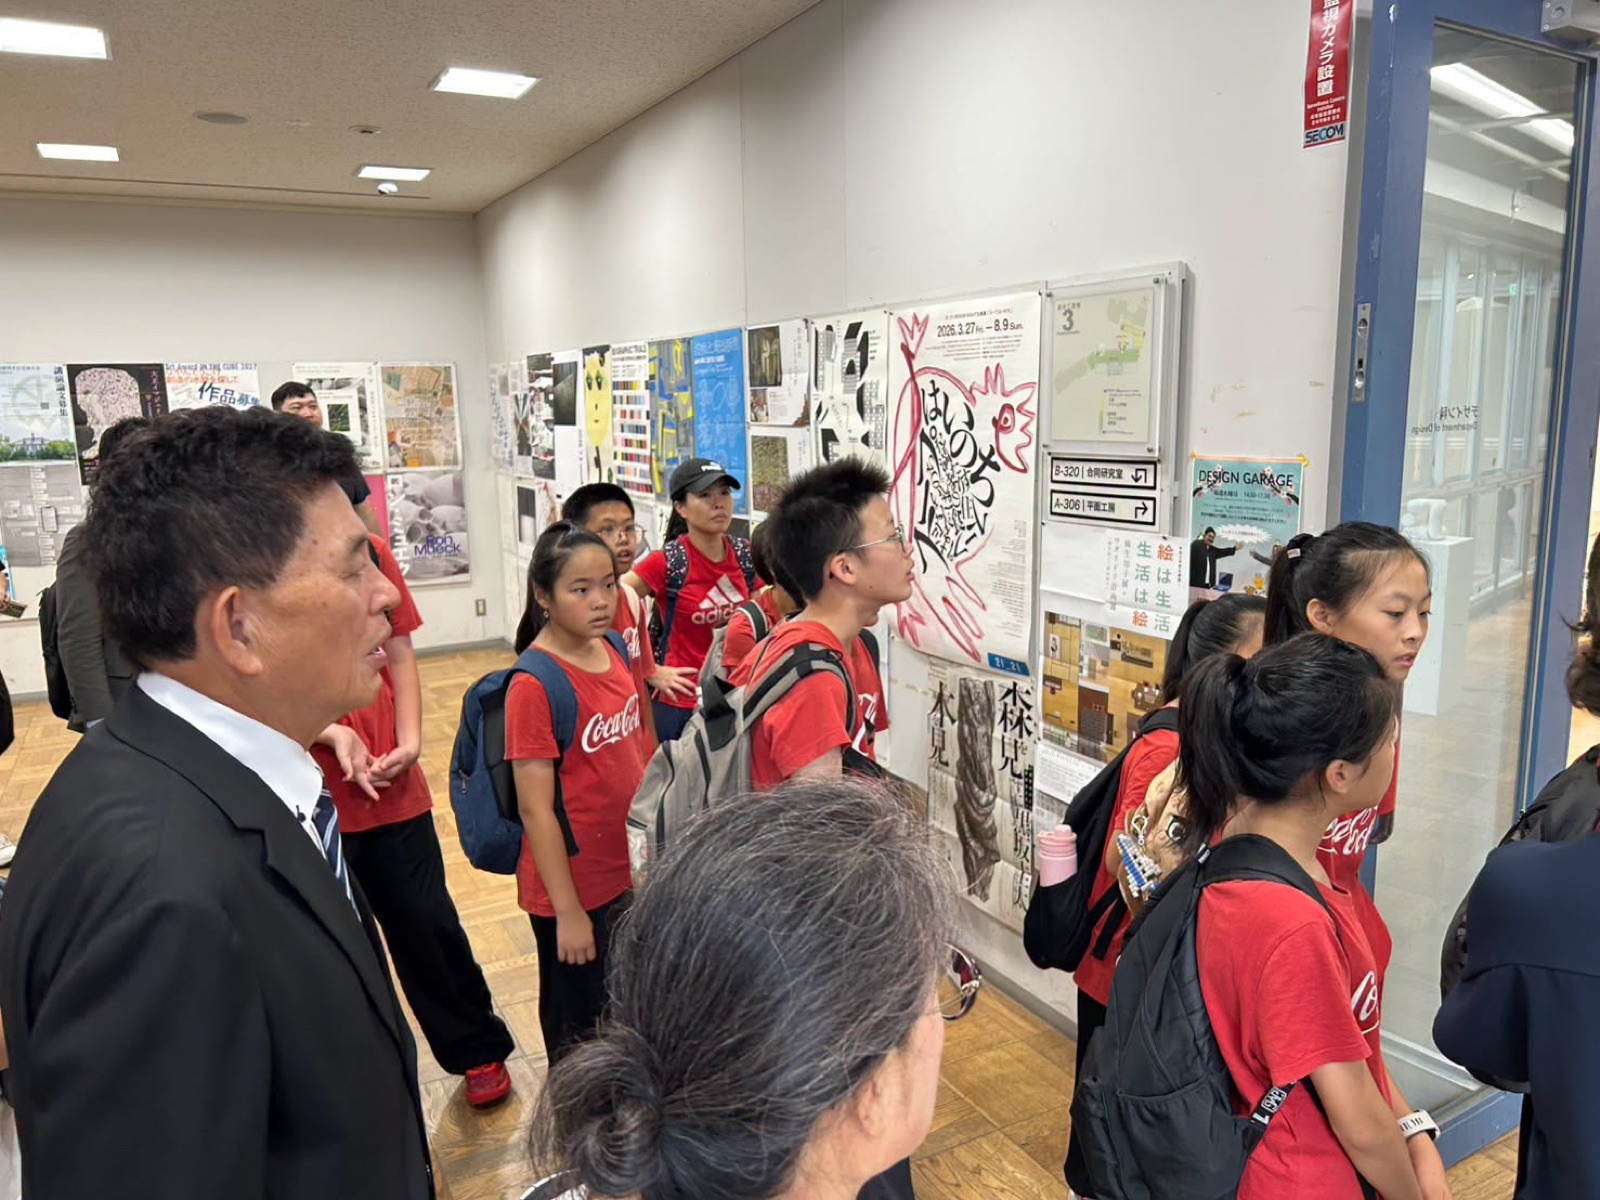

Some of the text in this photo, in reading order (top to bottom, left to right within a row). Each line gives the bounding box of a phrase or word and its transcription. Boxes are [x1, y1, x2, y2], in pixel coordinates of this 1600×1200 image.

[1305, 123, 1344, 143] SECOM
[1062, 309, 1074, 331] 3
[1054, 465, 1124, 480] B-320 合同研究室
[1198, 470, 1294, 487] DESIGN GARAGE
[1054, 498, 1116, 513] A-306 平面工房
[426, 534, 453, 546] Ron
[414, 543, 462, 557] Mueck
[1132, 540, 1153, 629] 生活は絵
[1154, 543, 1174, 633] 絵は生活
[692, 603, 735, 625] adid
